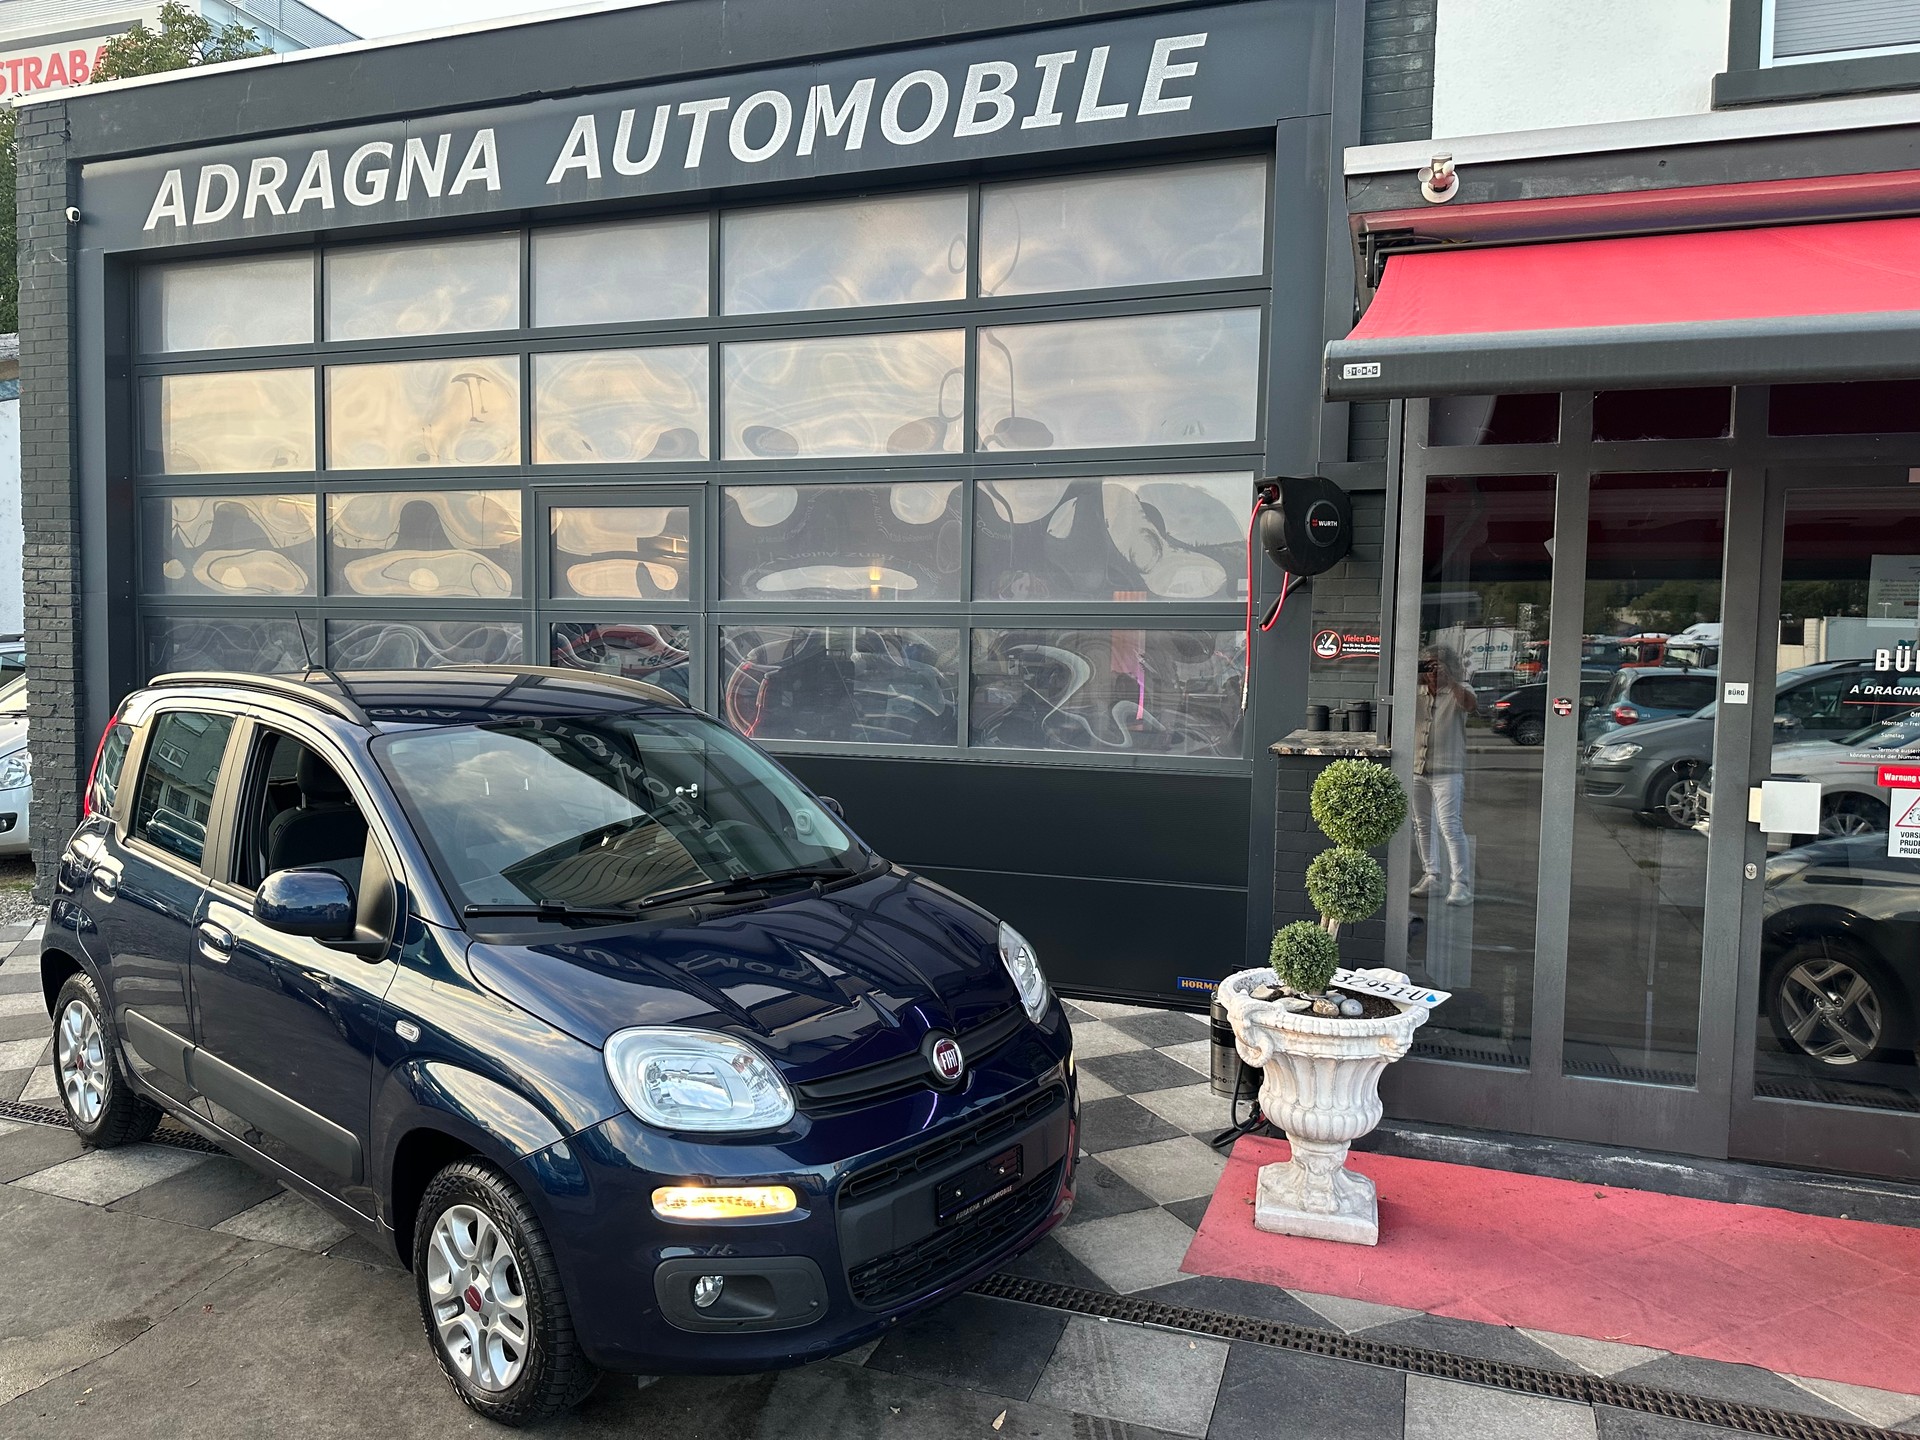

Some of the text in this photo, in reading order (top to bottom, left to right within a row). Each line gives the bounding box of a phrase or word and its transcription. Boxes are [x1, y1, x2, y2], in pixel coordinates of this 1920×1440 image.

[142, 33, 1208, 231] ADRAGNA AUTOMOBILE
[1342, 634, 1365, 642] Vielen
[1875, 645, 1920, 672] BÜ
[1884, 773, 1916, 783] Warnung
[940, 1049, 958, 1070] FIAT
[519, 1246, 544, 1334] UNIROYAL
